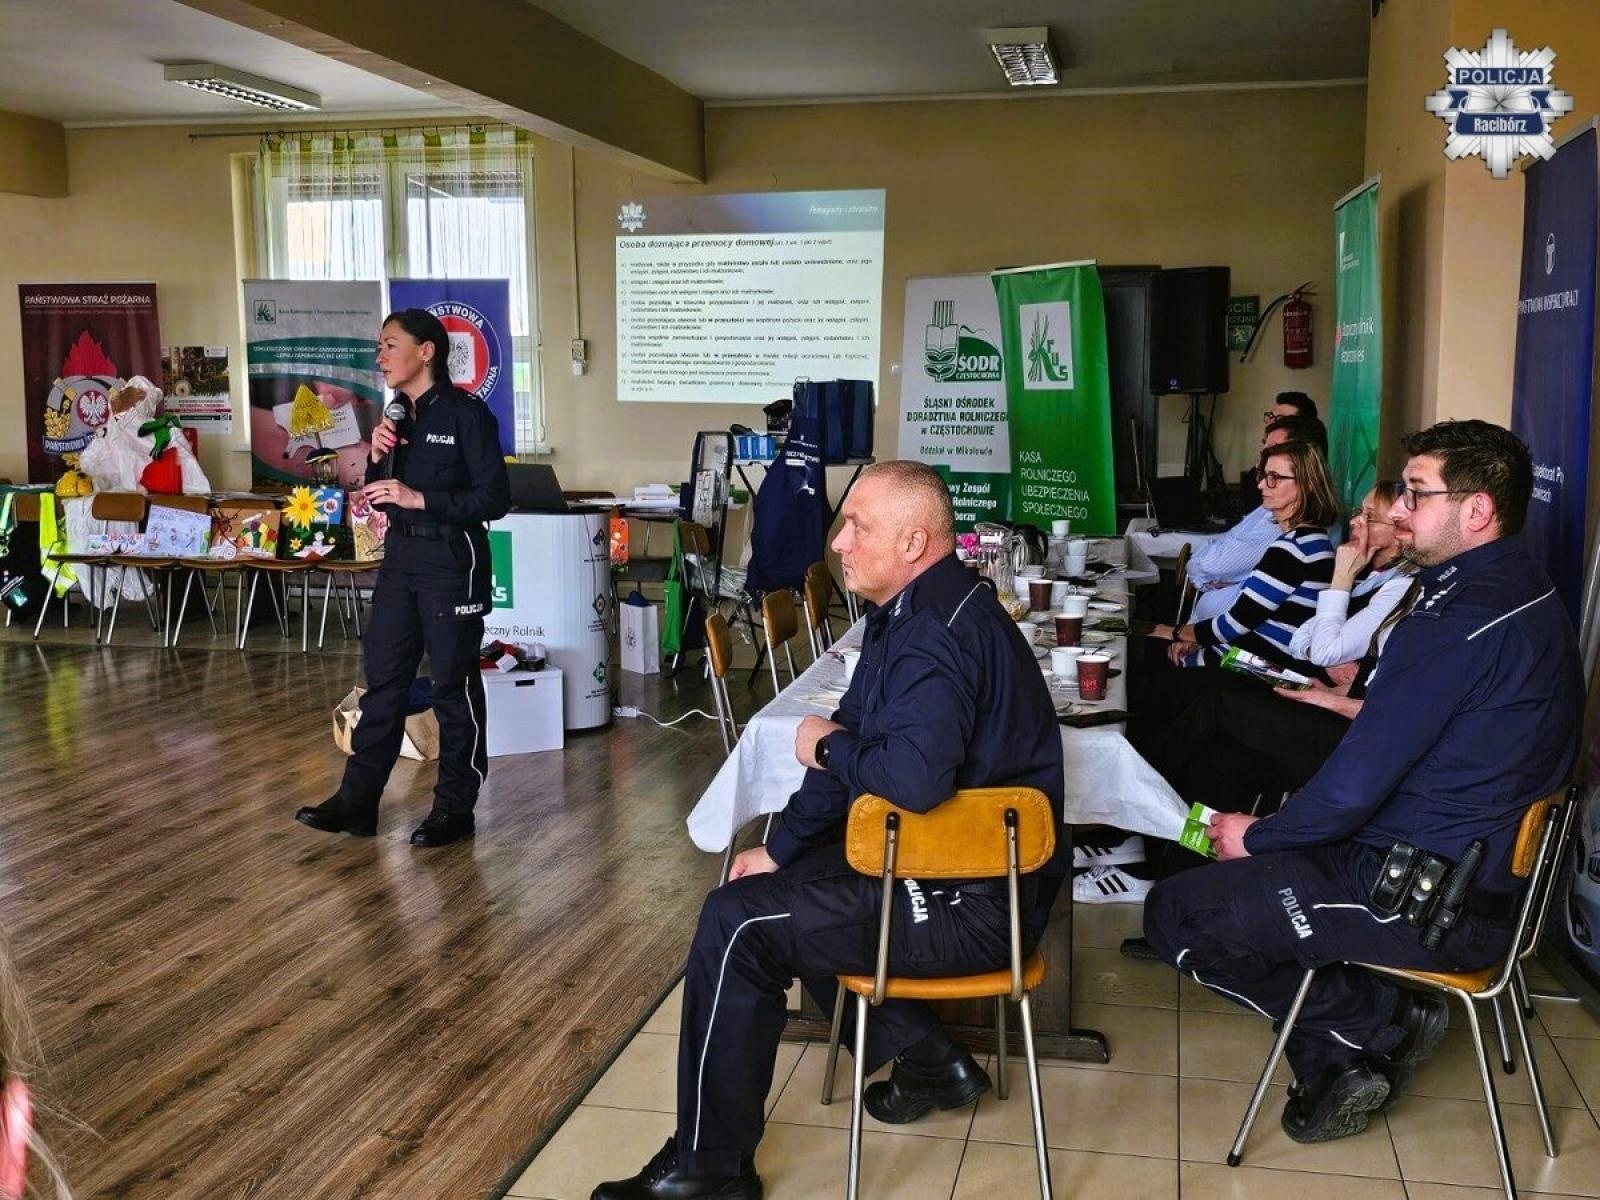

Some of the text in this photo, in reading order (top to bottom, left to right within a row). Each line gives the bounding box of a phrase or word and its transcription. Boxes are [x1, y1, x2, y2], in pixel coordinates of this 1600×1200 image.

[620, 240, 646, 249] Osoba
[692, 239, 733, 249] przemocy
[735, 238, 774, 248] domowej
[25, 293, 151, 305] PAŃSTWOWA STRAŻ POŻARNA
[475, 366, 498, 399] TARNA
[923, 395, 996, 410] ŚLĄSKI OŚRODEK
[906, 411, 957, 422] DORADZTWA
[930, 424, 995, 438] CZĘSTOCHOWIE
[426, 433, 455, 445] POLICJA
[1019, 450, 1042, 463] KASA
[1020, 467, 1077, 484] ROLNICZEGO
[963, 482, 991, 494] Zespół
[1021, 485, 1090, 502] UBEZPIECZENIA
[952, 496, 997, 510] Rolniczego
[955, 510, 977, 521] borzu
[1022, 501, 1088, 520] SPOŁECZNEGO
[455, 603, 484, 616] POLICJA
[485, 625, 546, 638] eczny Rolnik
[904, 879, 929, 924] OLICJA
[1277, 887, 1314, 940] POLICJA
